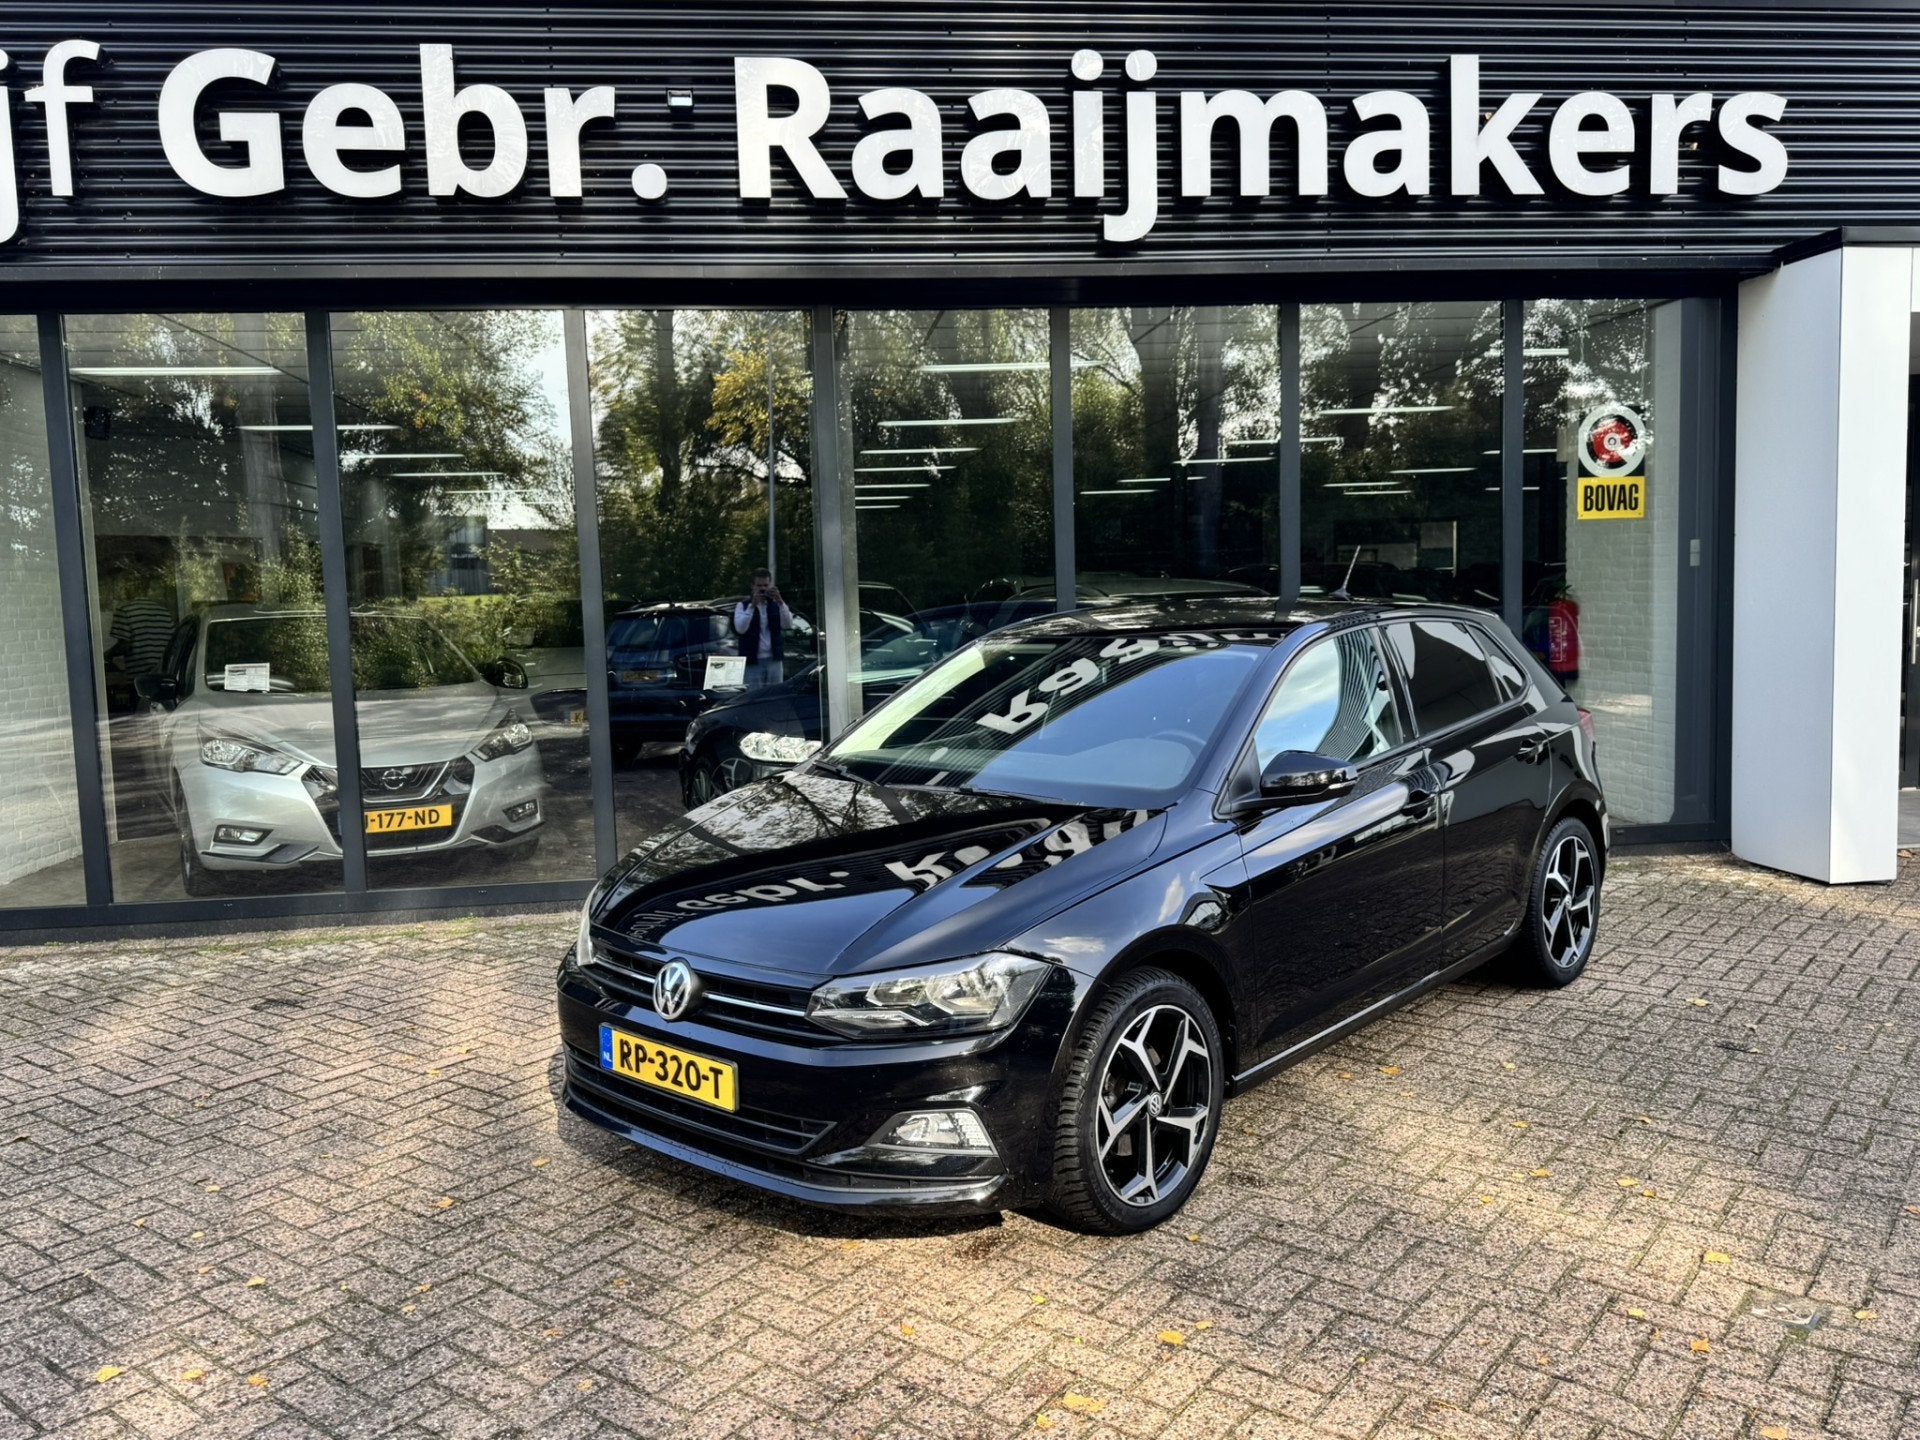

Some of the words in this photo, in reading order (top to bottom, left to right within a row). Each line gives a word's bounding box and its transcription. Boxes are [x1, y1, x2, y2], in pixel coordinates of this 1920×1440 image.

[158, 43, 668, 200] Gebr.
[734, 49, 1789, 243] Raaijmakers
[1583, 483, 1640, 513] BOVAG
[602, 1050, 613, 1063] NL
[619, 1038, 724, 1100] RP-320-T
